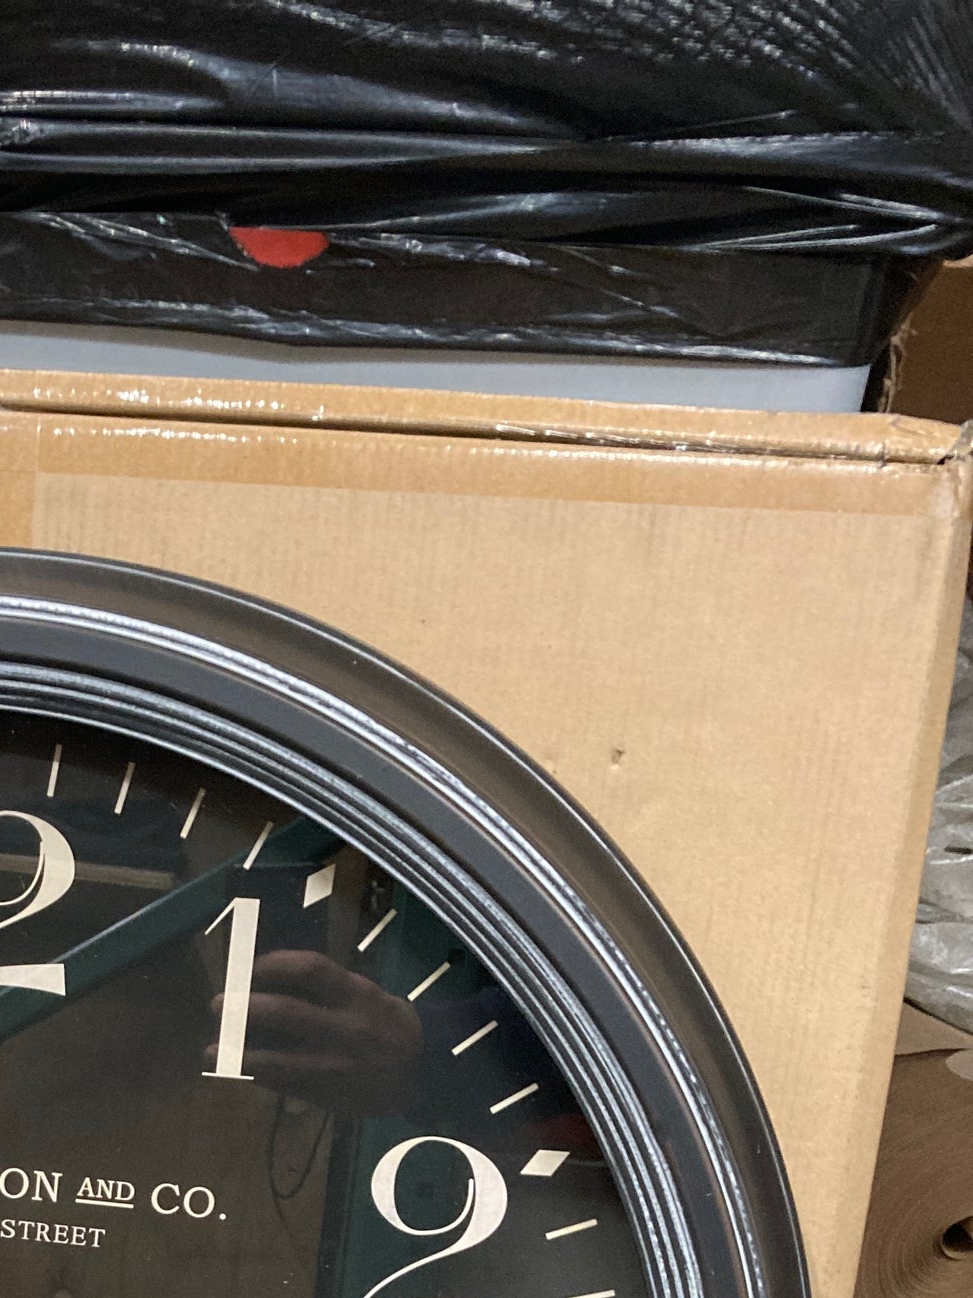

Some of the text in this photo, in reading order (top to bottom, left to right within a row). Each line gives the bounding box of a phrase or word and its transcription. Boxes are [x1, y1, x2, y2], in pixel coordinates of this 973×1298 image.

[201, 897, 261, 1080] 1
[75, 1176, 136, 1209] AND
[150, 1182, 227, 1221] CO.
[0, 1218, 106, 1248] STREET
